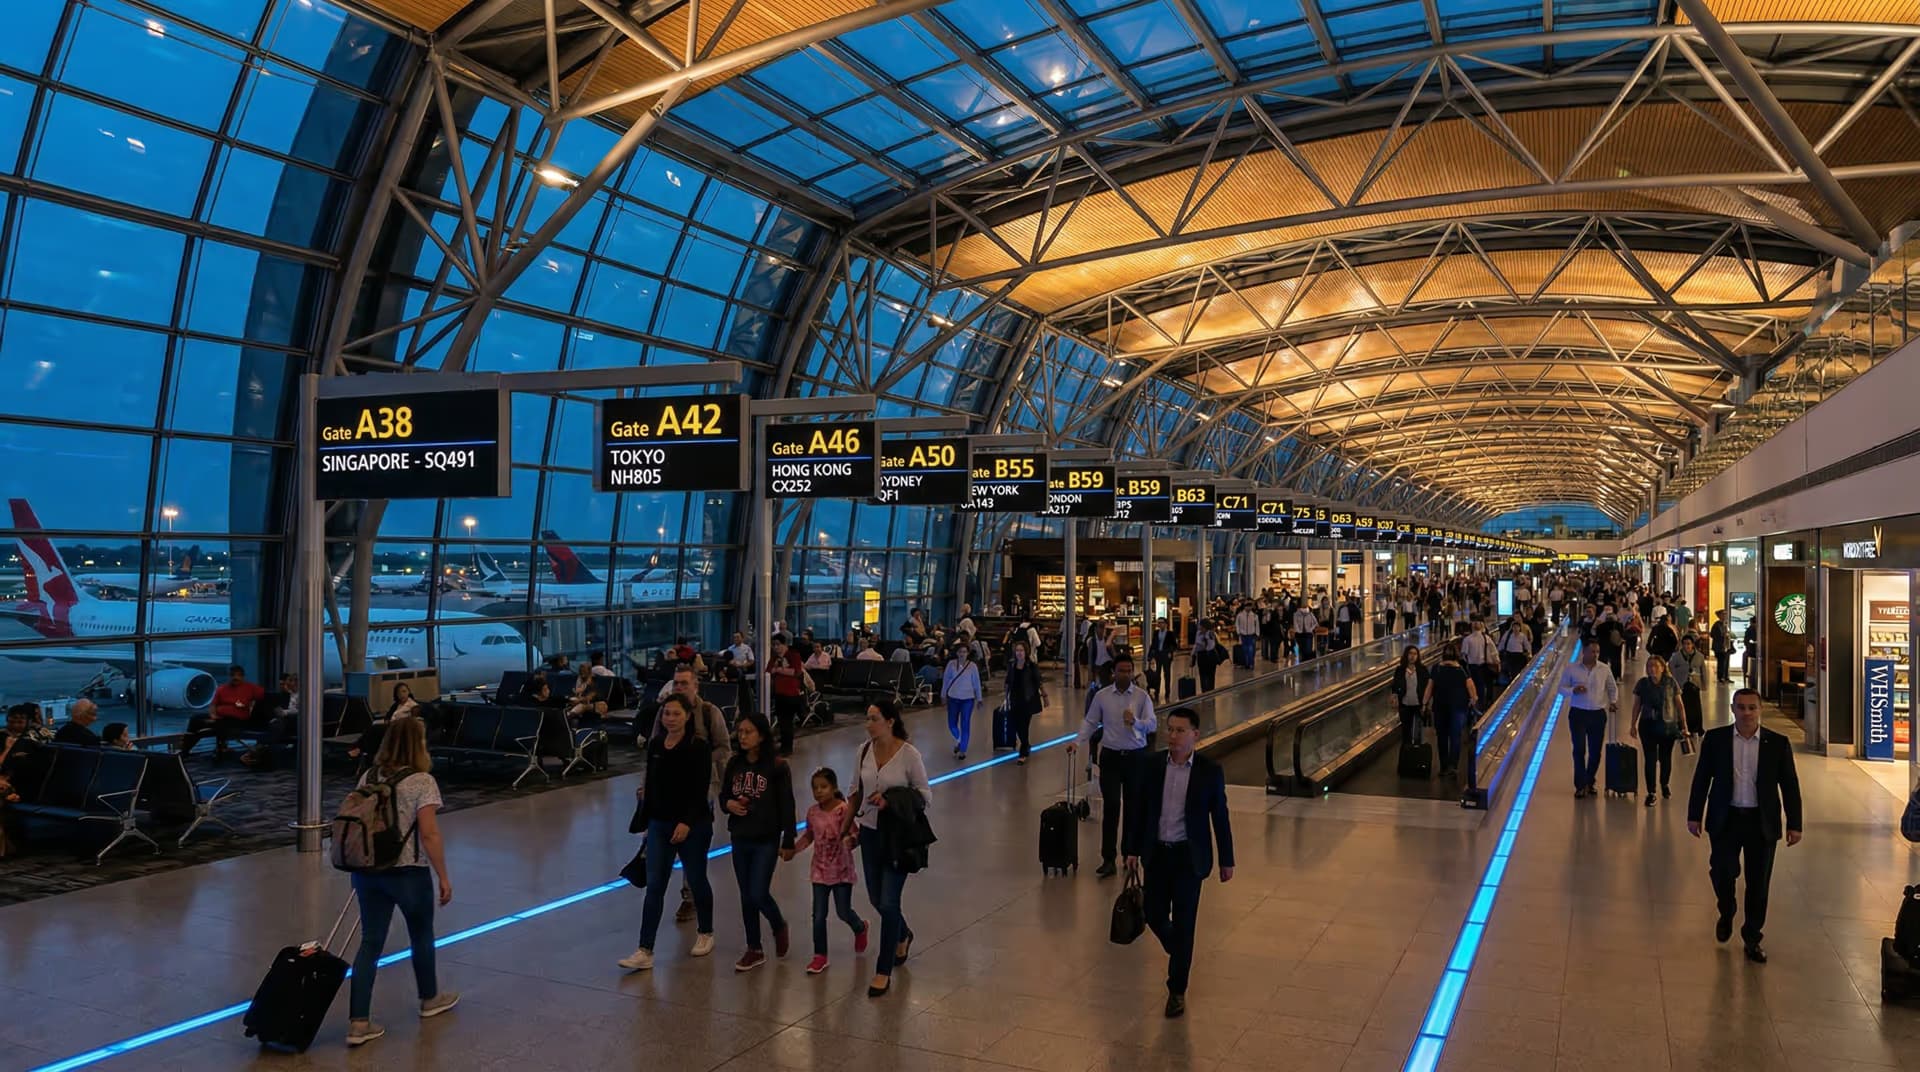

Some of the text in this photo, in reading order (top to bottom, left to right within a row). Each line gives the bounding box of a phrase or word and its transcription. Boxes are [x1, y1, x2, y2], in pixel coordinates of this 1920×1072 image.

[322, 406, 413, 441] Gate A38
[611, 404, 722, 438] Gate A42
[772, 429, 860, 456] Gate A46
[322, 451, 410, 472] SINGAPORE
[424, 450, 475, 470] SQ491
[610, 449, 666, 466] TOKYO
[909, 445, 956, 468] A50
[611, 469, 662, 485] NH805
[772, 463, 852, 477] HONG KONG
[972, 458, 1034, 479] ate B55
[772, 480, 812, 493] CX252
[1069, 471, 1104, 489] B59
[1129, 480, 1161, 496] B59
[972, 484, 1019, 496] EW YORK
[1177, 488, 1206, 503] B63
[1223, 495, 1248, 509] C71
[1870, 664, 1889, 744] WHSmith
